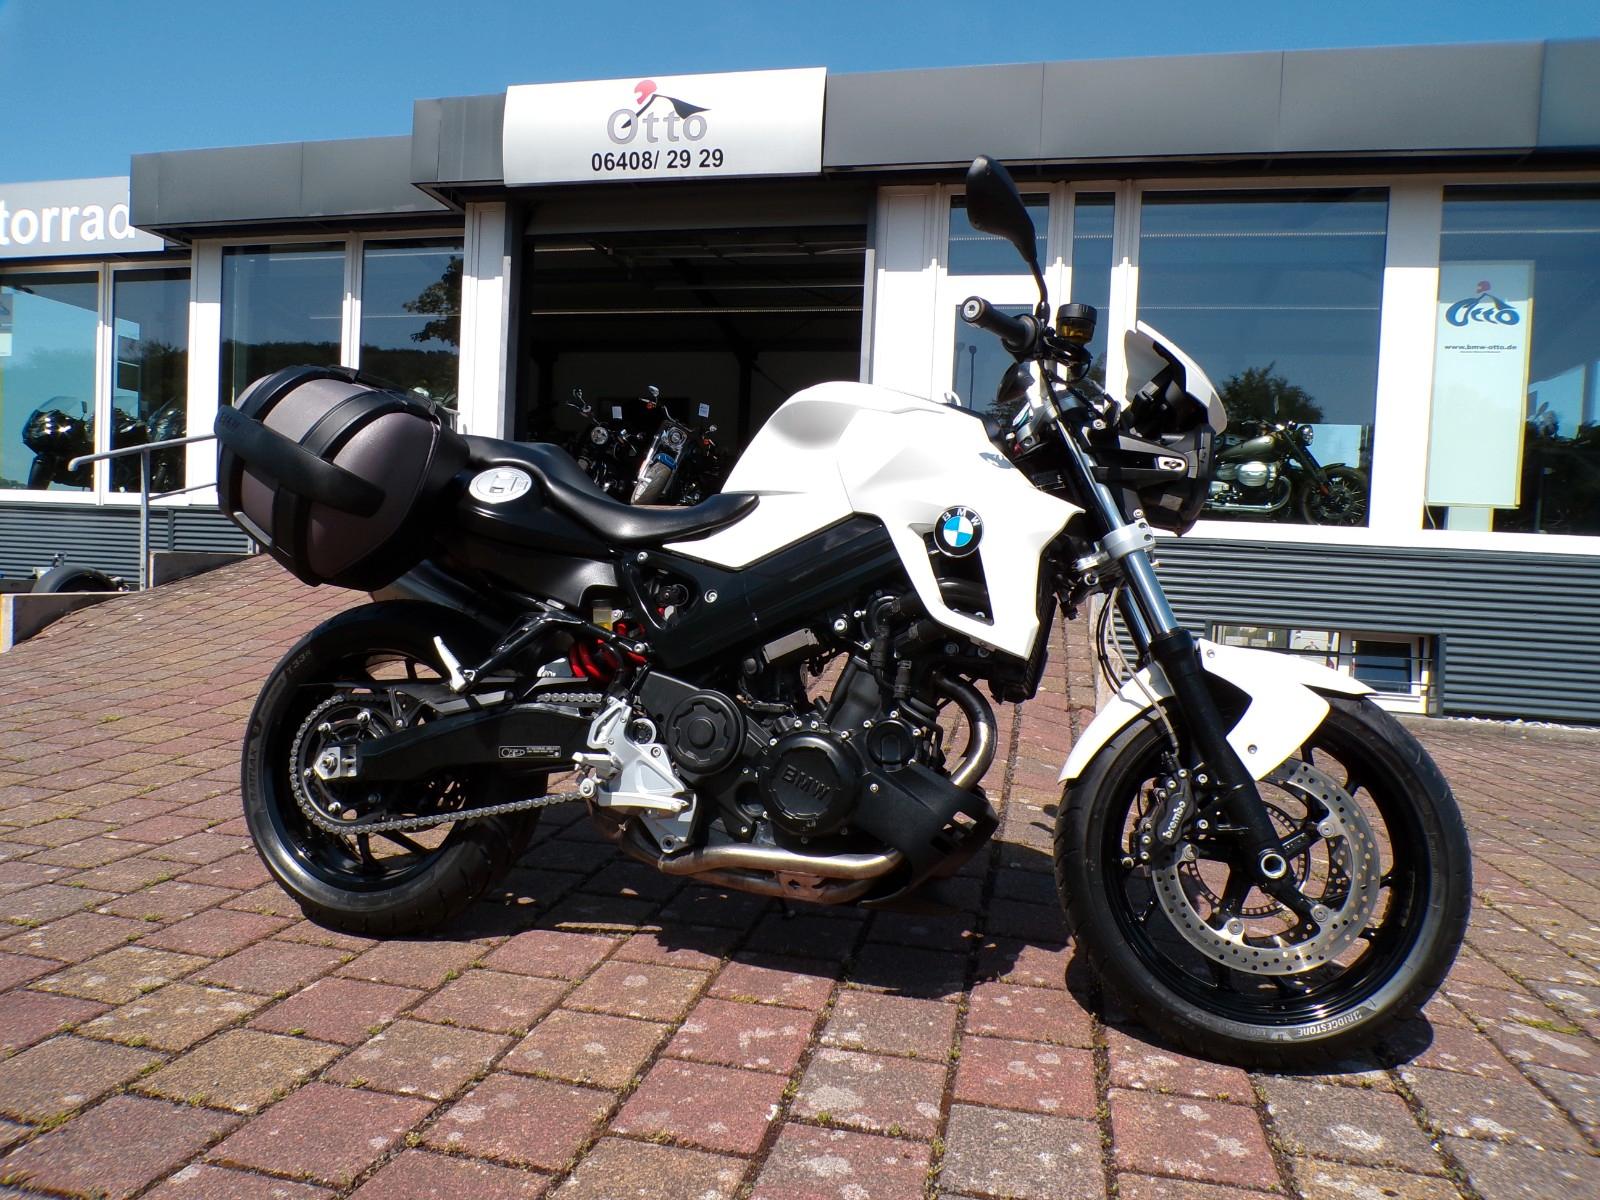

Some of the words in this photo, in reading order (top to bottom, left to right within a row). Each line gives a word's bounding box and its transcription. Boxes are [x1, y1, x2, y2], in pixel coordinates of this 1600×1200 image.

[606, 108, 708, 145] Otto
[591, 150, 660, 172] 06408/
[666, 149, 692, 170] 29
[698, 148, 725, 169] 29
[1444, 343, 1518, 351] www.bmw-otto.de
[942, 508, 982, 527] BMW
[782, 764, 831, 801] BMW
[1162, 801, 1187, 839] brembo
[1296, 1010, 1364, 1038] BRIDGESTONE
